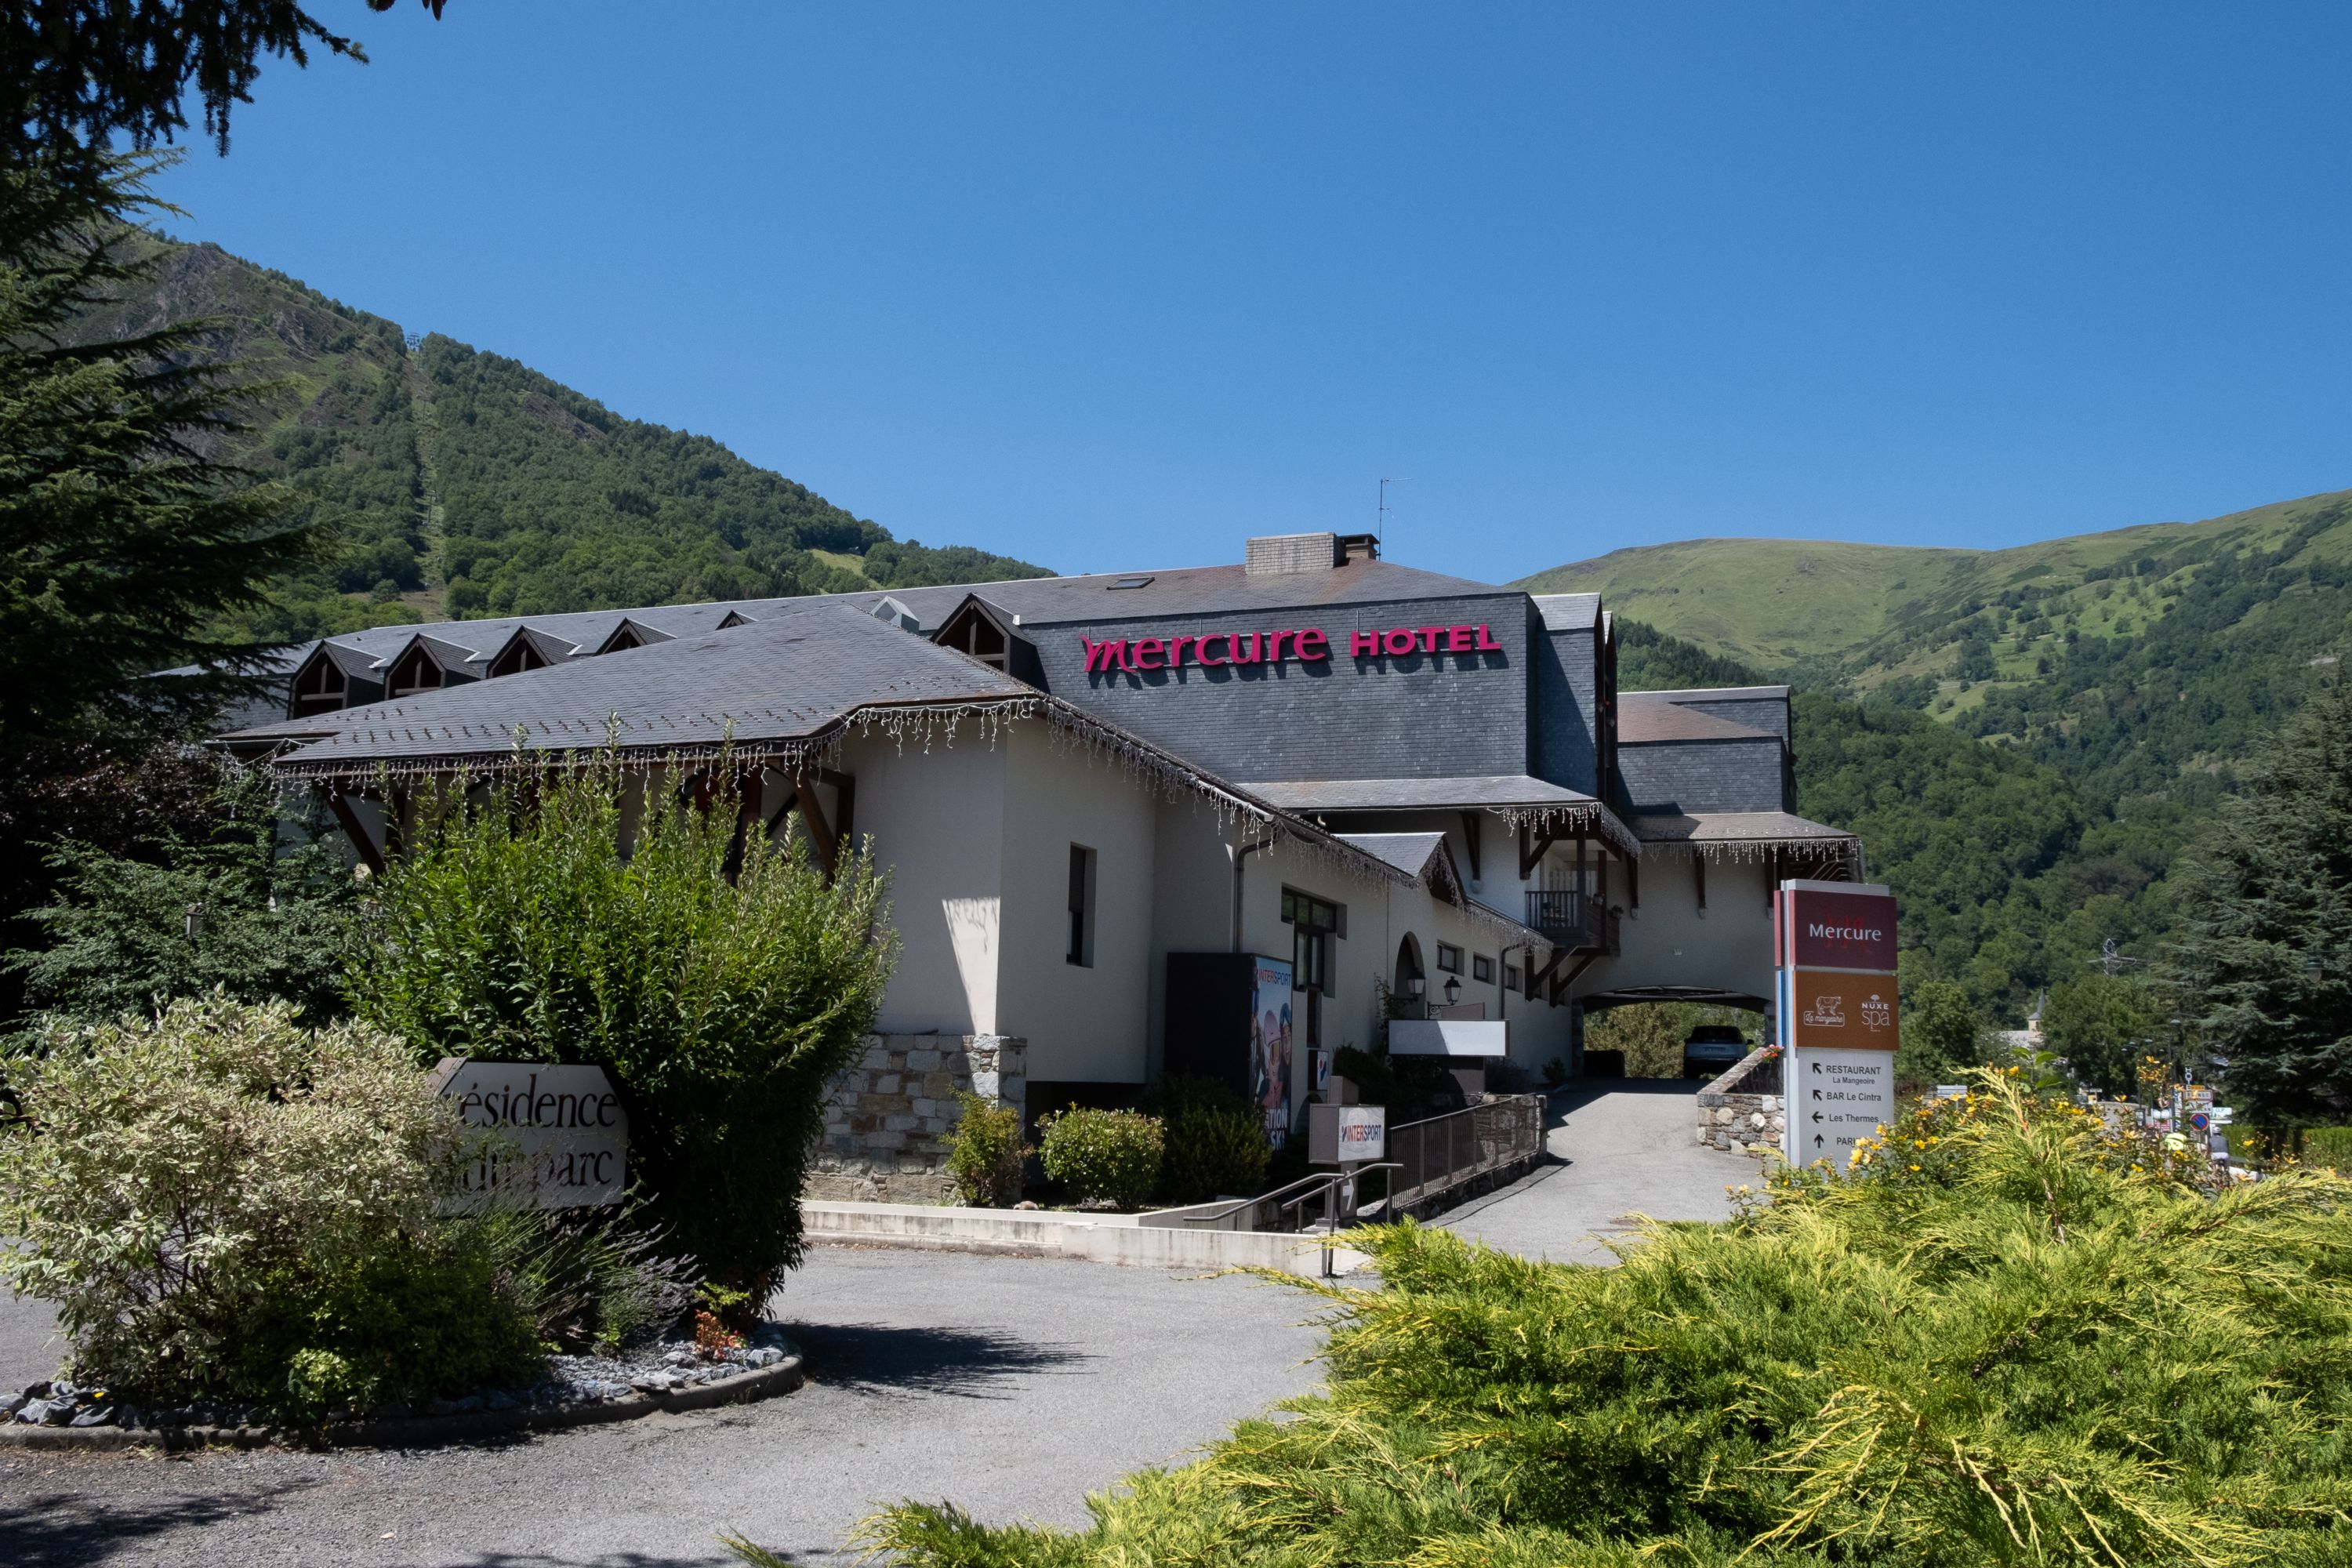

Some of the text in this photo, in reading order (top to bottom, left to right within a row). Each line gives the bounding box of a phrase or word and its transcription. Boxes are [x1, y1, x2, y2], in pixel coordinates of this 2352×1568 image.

[1351, 623, 1502, 657] HOTEL
[1809, 923, 1882, 942] Mercure
[1258, 968, 1291, 986] INTERSPORT
[1861, 1011, 1890, 1029] spa
[1826, 1065, 1881, 1075] RESTAURANT
[1842, 1077, 1875, 1086] Mangeoire
[444, 1073, 619, 1128] ésidence
[1858, 1093, 1882, 1102] Cintra
[1829, 1113, 1879, 1123] Les Thermes
[1347, 1124, 1381, 1142] INTERSPORT
